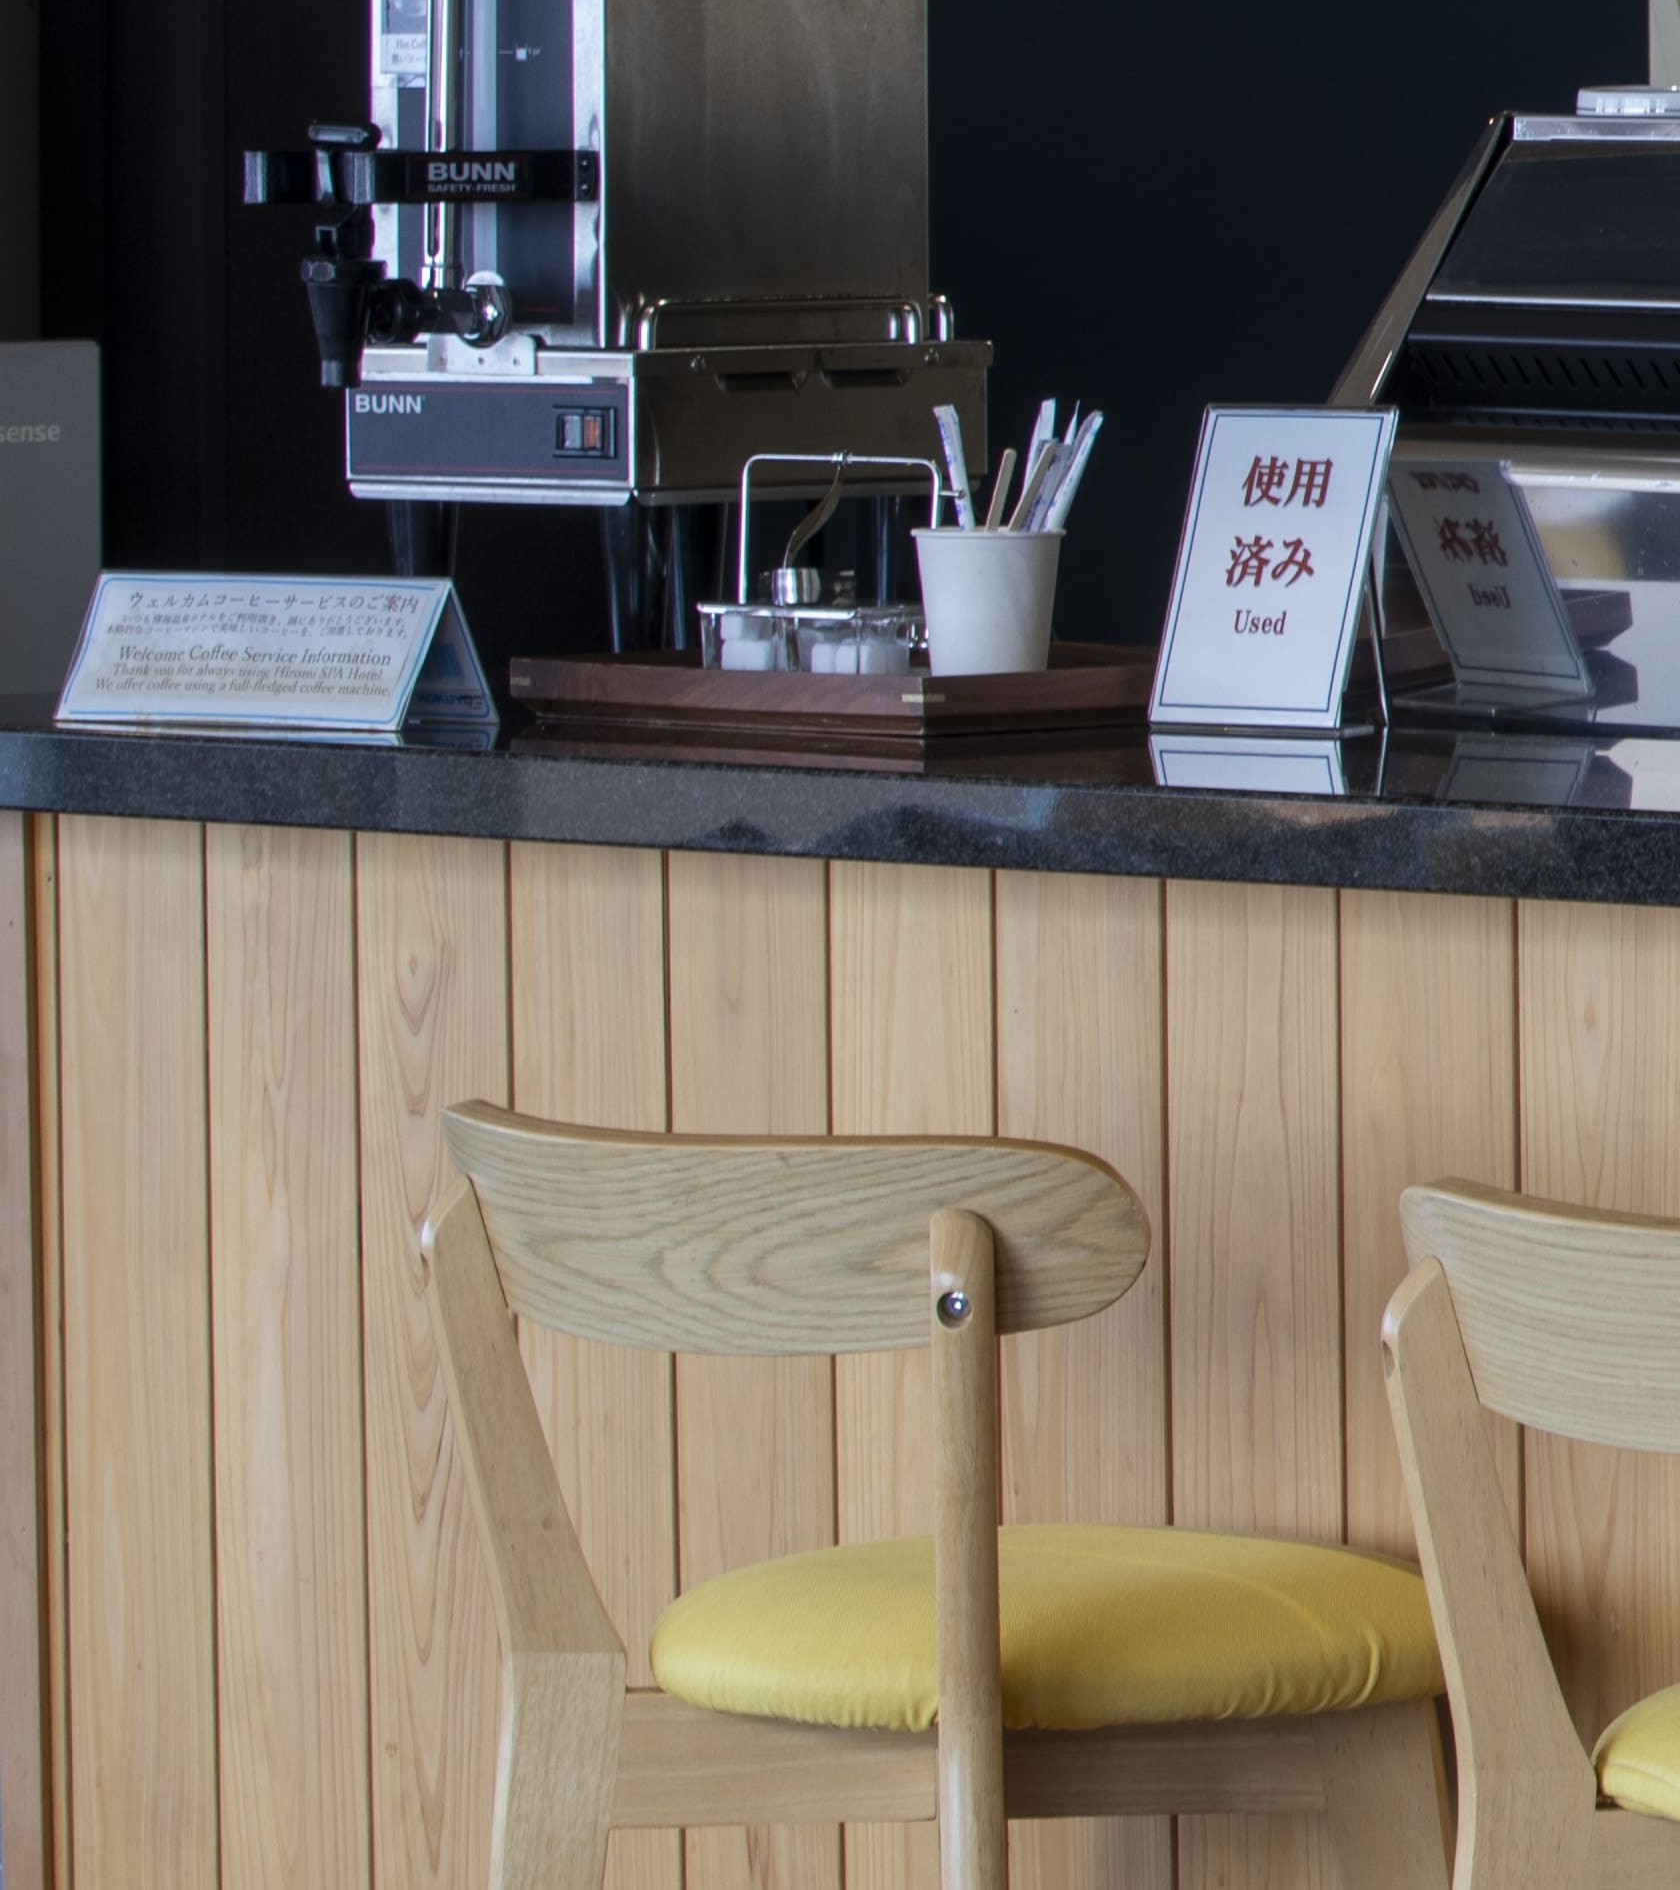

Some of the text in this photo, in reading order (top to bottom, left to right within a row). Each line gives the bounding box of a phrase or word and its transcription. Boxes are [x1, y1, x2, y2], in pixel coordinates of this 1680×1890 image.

[428, 162, 515, 182] BUNN
[428, 183, 515, 193] SAFETY-FRESH
[355, 392, 423, 416] BUNN
[1242, 457, 1333, 508] 使用
[1225, 535, 1315, 588] 済み
[1234, 609, 1287, 636] Used
[119, 643, 392, 666] Welcome Coffee Service Information
